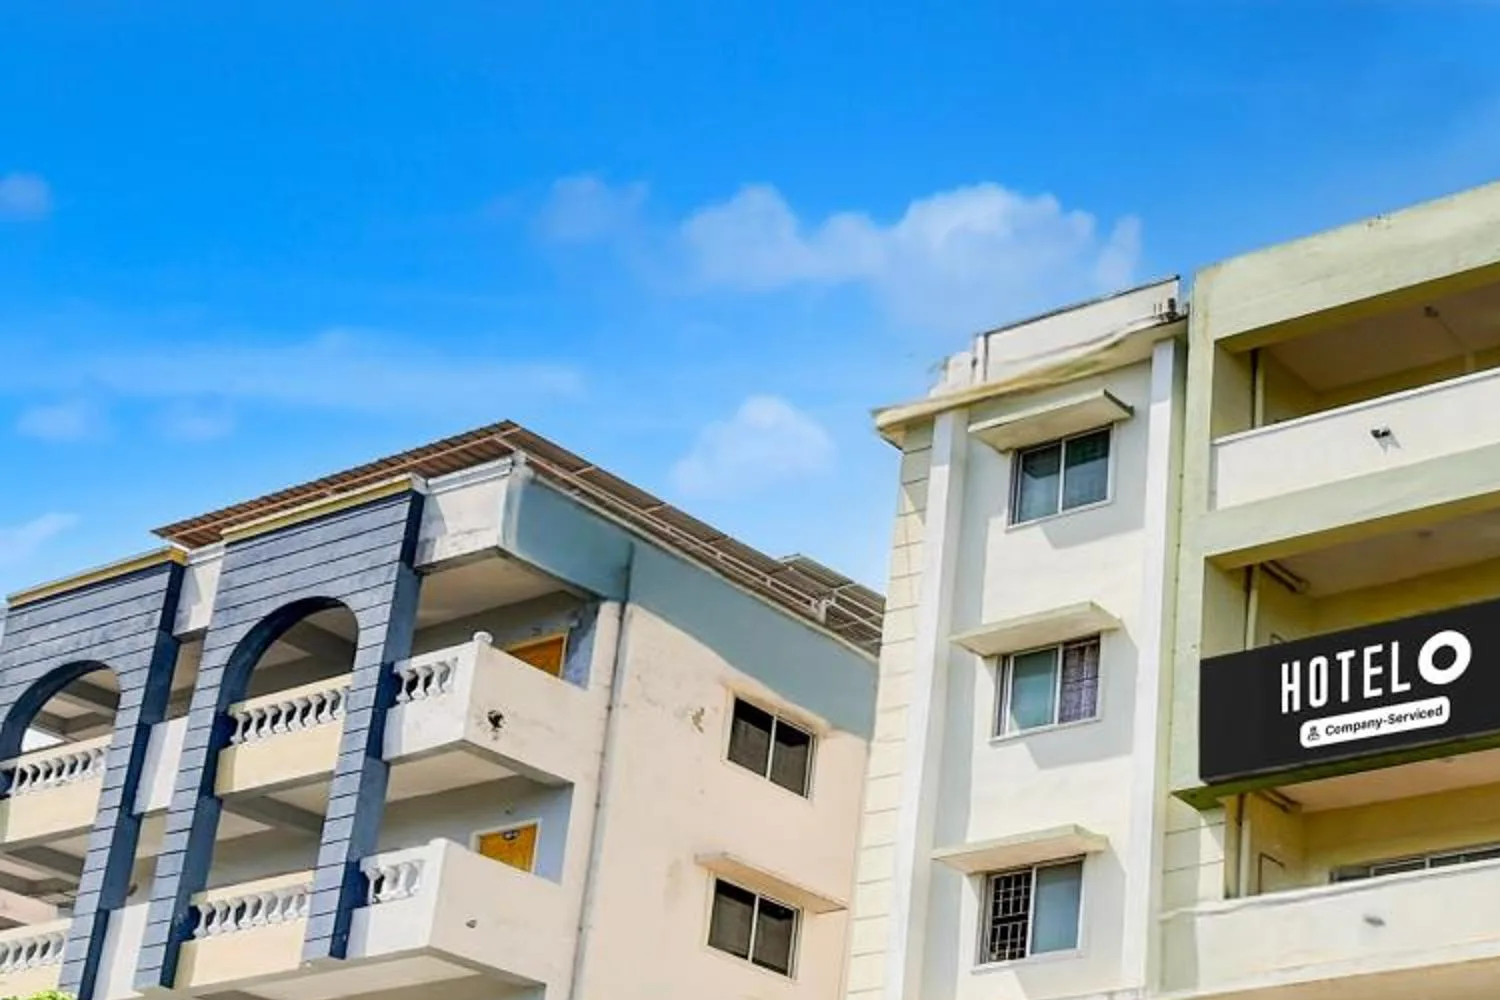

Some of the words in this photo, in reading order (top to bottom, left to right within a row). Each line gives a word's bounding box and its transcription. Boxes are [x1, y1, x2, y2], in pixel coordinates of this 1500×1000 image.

[1281, 641, 1411, 714] HOTEL
[1418, 630, 1472, 685] O
[1325, 704, 1443, 736] Company-Serviced
